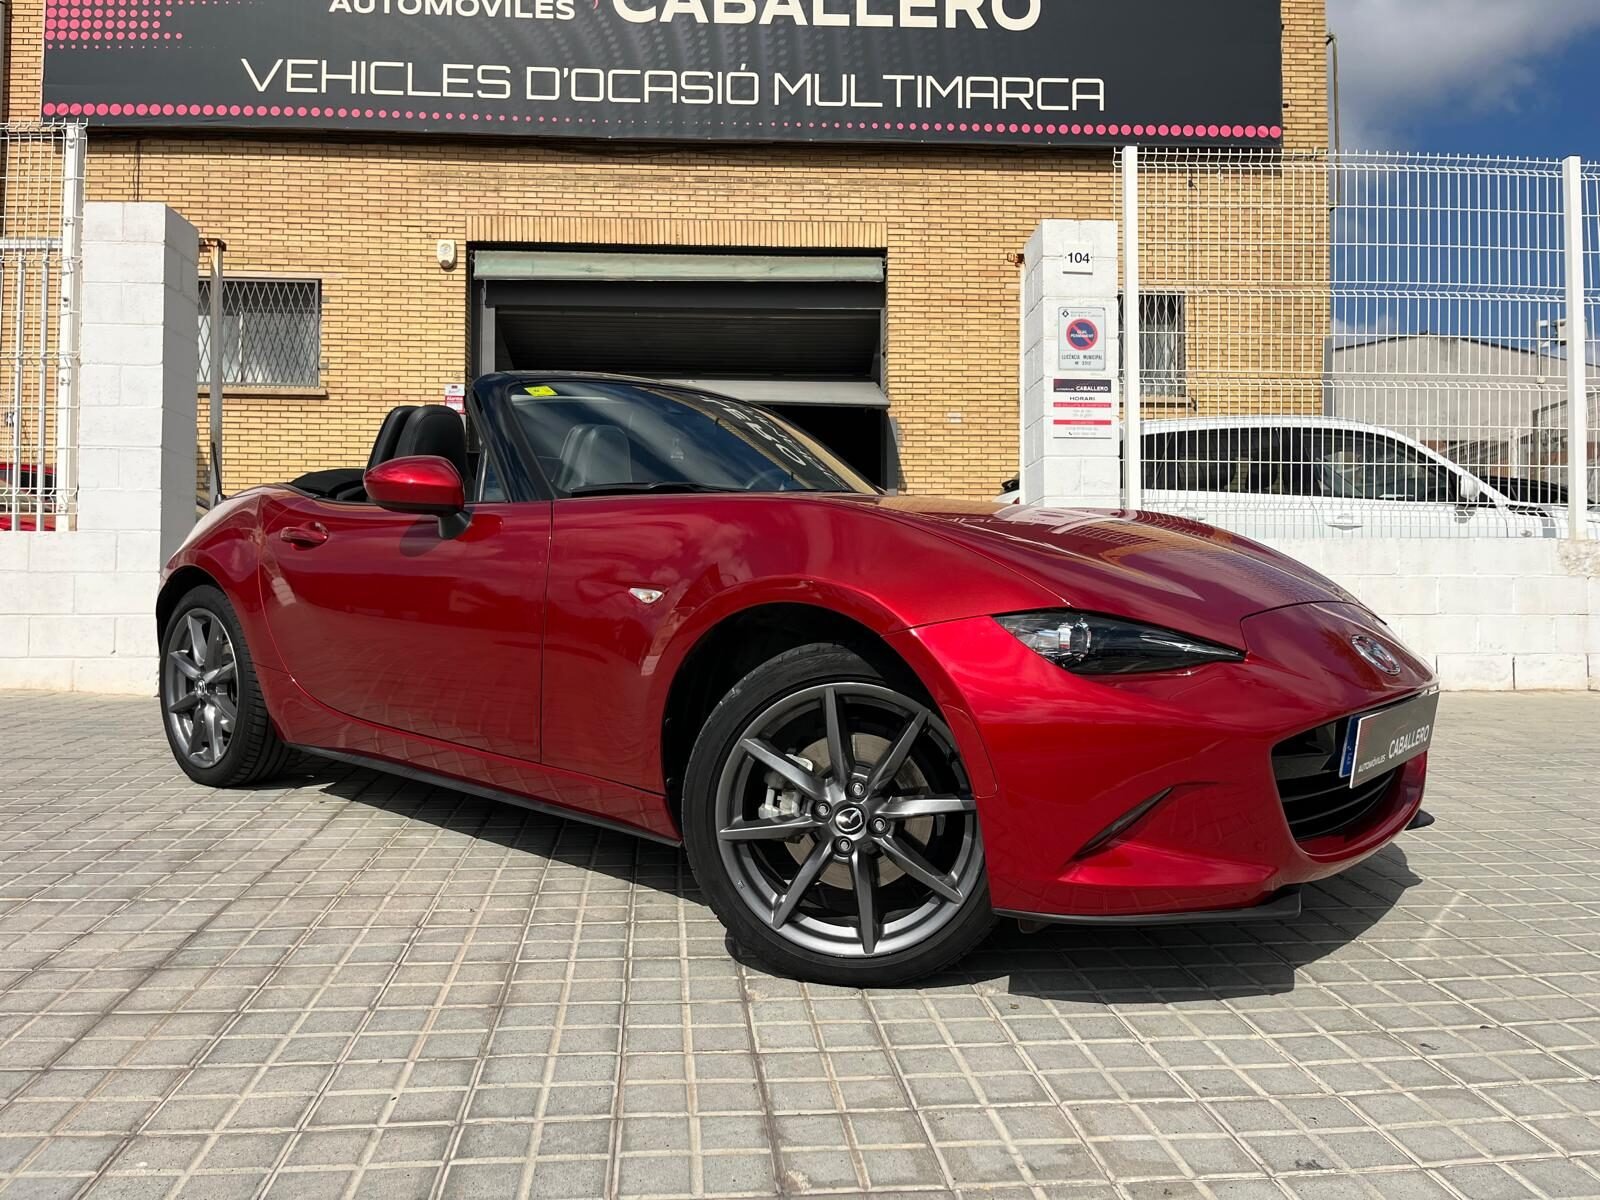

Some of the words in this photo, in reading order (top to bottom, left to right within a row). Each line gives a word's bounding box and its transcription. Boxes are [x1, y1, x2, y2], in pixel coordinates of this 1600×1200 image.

[613, 0, 1042, 31] CABALLERO
[241, 58, 511, 99] VEHICLES
[526, 63, 759, 105] D'OCASIÓ
[774, 72, 1105, 111] MULTIMARCA
[1067, 252, 1090, 264] 104
[1388, 724, 1430, 759] CABALLERO
